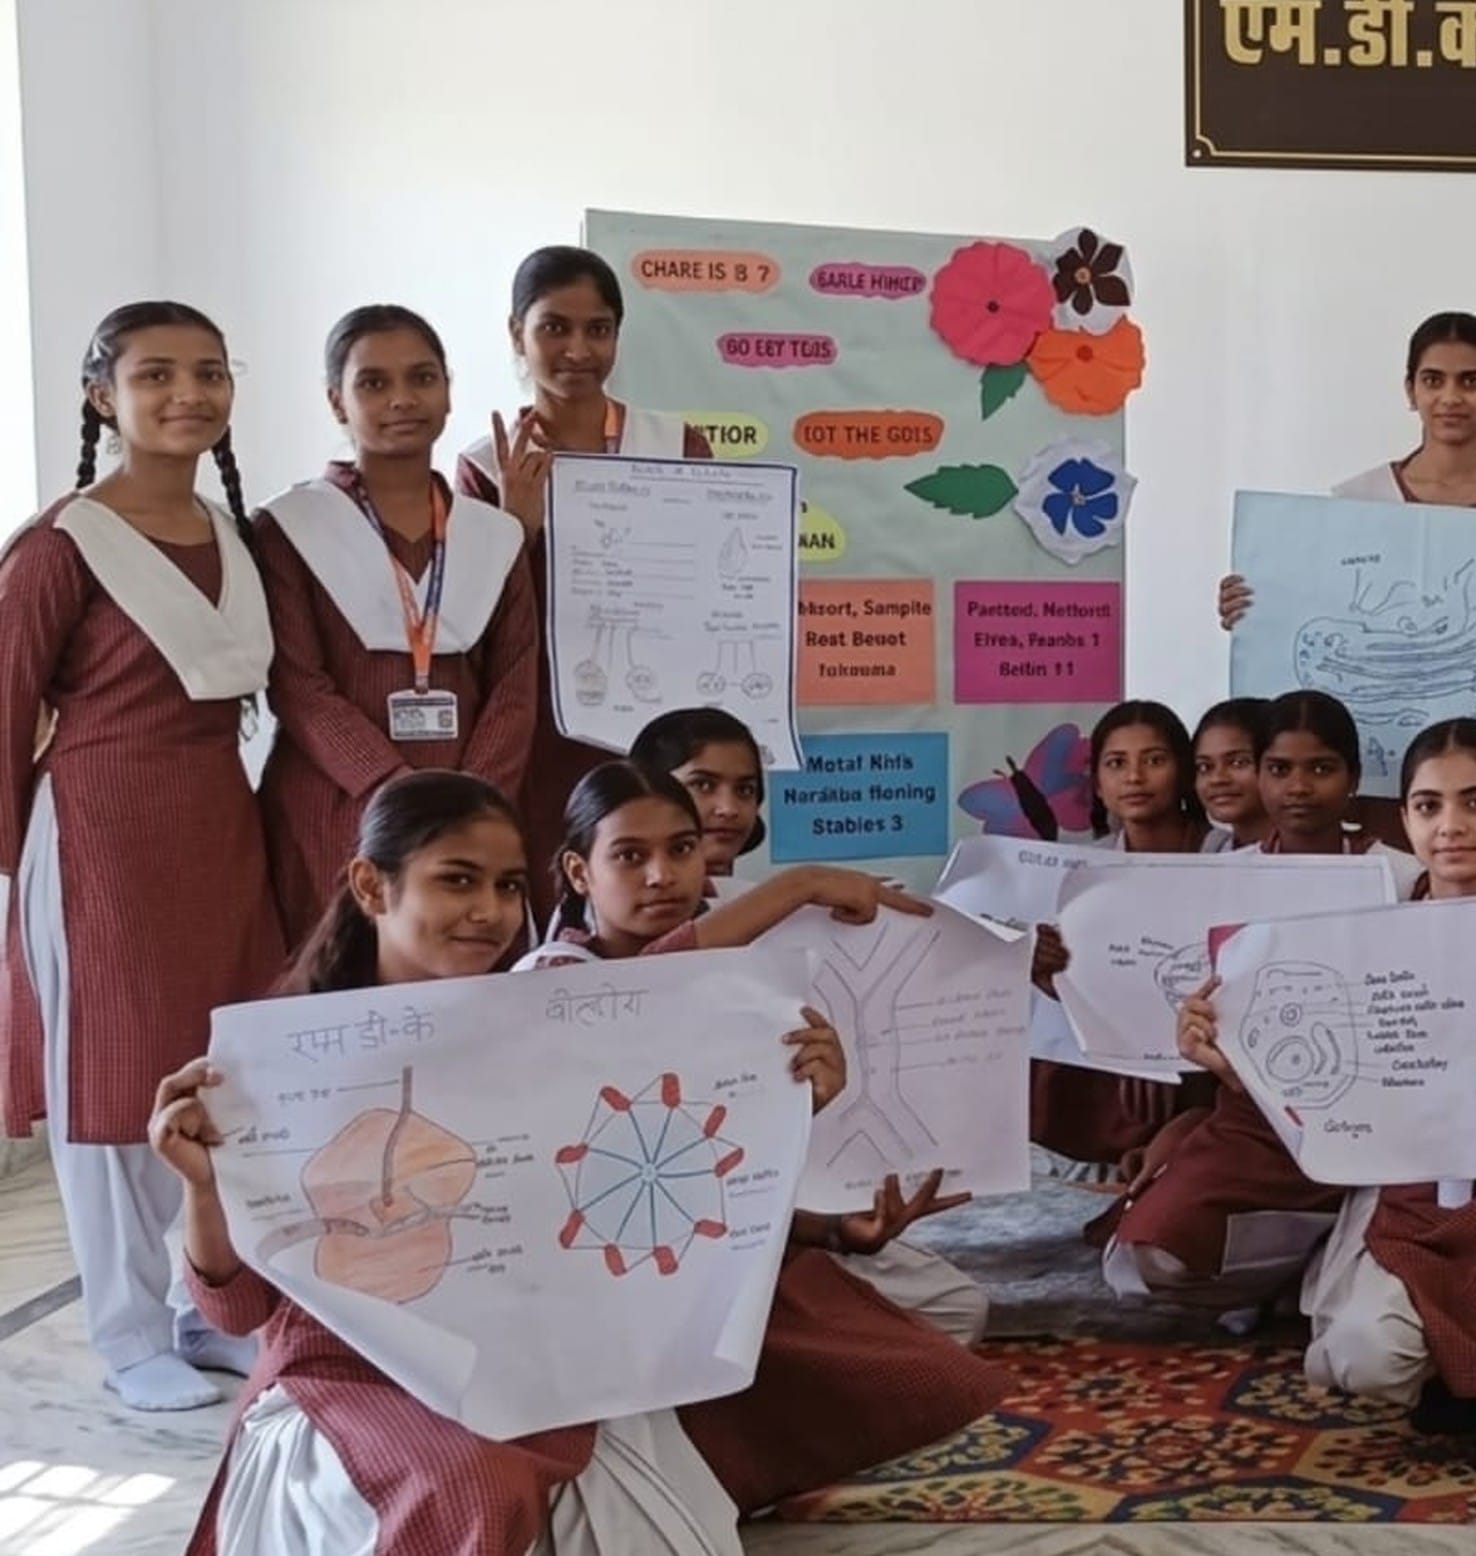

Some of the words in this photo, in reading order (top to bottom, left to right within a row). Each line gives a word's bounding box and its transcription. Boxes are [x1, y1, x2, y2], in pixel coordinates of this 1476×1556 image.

[641, 260, 702, 279] CHARE
[708, 262, 727, 280] IS
[844, 426, 880, 444] THE
[890, 814, 904, 832] 3
